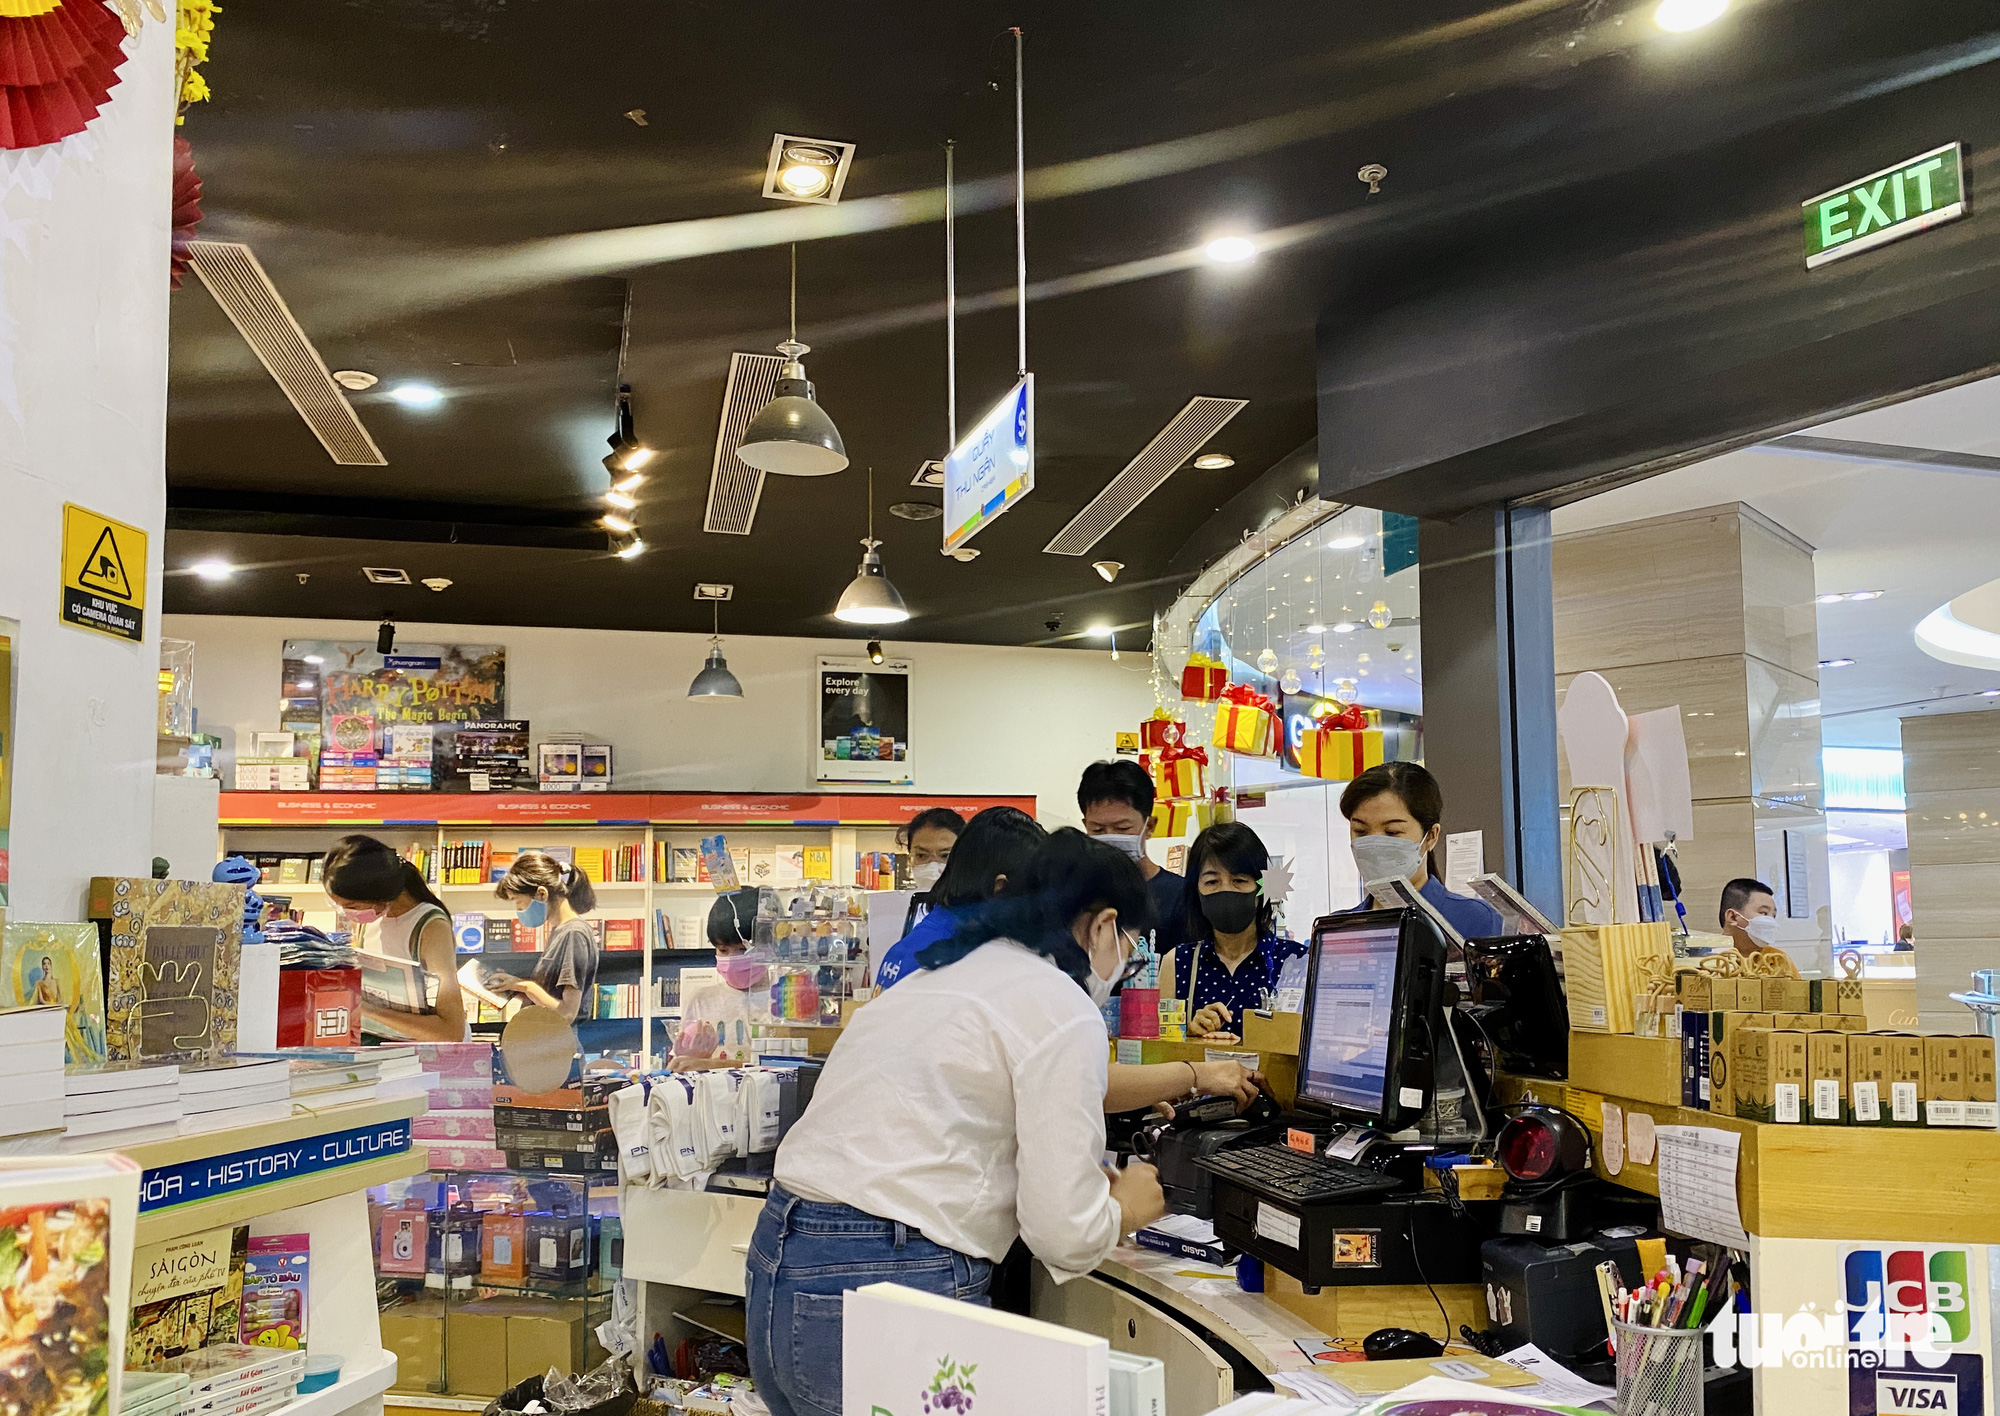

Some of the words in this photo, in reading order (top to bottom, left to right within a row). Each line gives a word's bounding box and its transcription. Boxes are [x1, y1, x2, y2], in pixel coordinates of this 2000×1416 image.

[1819, 157, 1941, 248] EXIT
[91, 597, 105, 610] KHU
[71, 602, 81, 614] CÓ
[81, 606, 107, 622] CAMERA
[107, 613, 123, 627] QUAN
[124, 618, 136, 630] SÁT
[825, 677, 860, 688] Explore
[327, 674, 410, 708] HARRY
[825, 687, 850, 697] every
[852, 687, 869, 697] day
[377, 706, 397, 721] The
[402, 706, 433, 724] Magic
[439, 707, 468, 725] Begin
[464, 721, 522, 731] PANORAMIC
[239, 782, 259, 790] 1000
[543, 783, 561, 791] 1000
[809, 852, 827, 863] MBA
[522, 936, 535, 944] LIFE
[207, 1149, 302, 1189] HISTORY
[322, 1128, 404, 1162] CULTURE
[1181, 1244, 1207, 1258] CASIO
[263, 1272, 278, 1284] TÔ
[278, 1271, 302, 1284] MÀU
[1844, 1280, 1966, 1313] JCB
[1885, 1386, 1948, 1411] VISA
